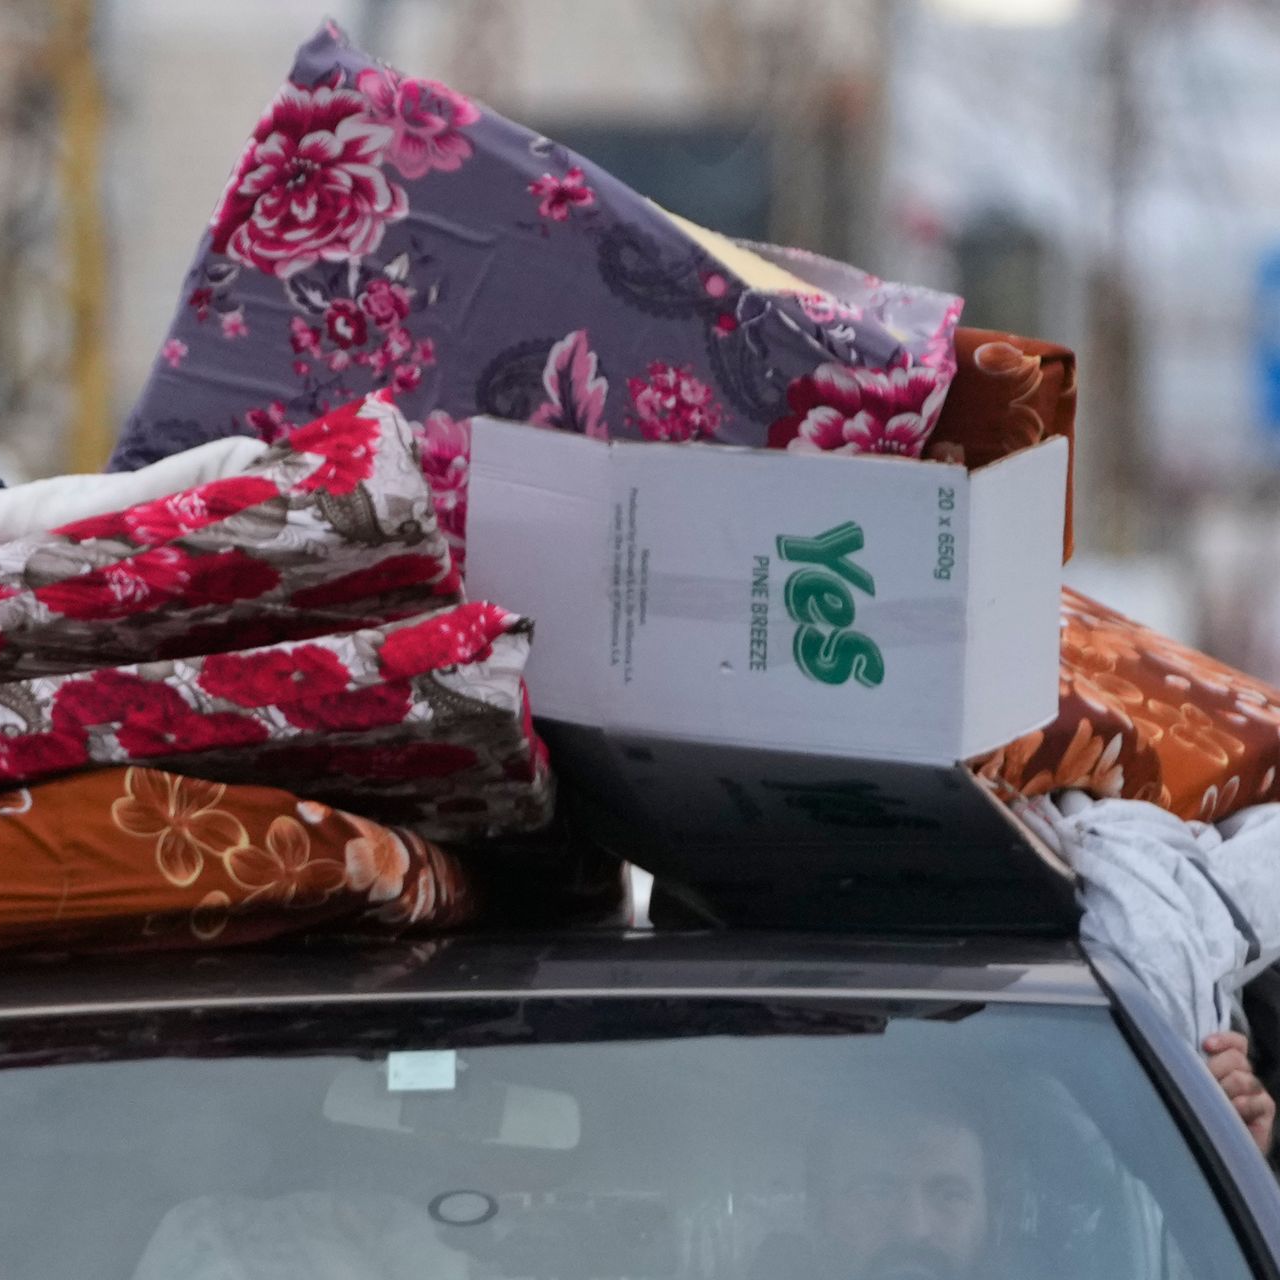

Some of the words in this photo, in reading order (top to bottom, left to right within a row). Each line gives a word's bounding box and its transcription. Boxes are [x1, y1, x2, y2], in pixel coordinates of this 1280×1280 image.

[938, 487, 955, 511] 20
[938, 516, 952, 527] x
[750, 555, 770, 599] PINE
[933, 533, 956, 581] 650g
[748, 602, 768, 672] BREEZE
